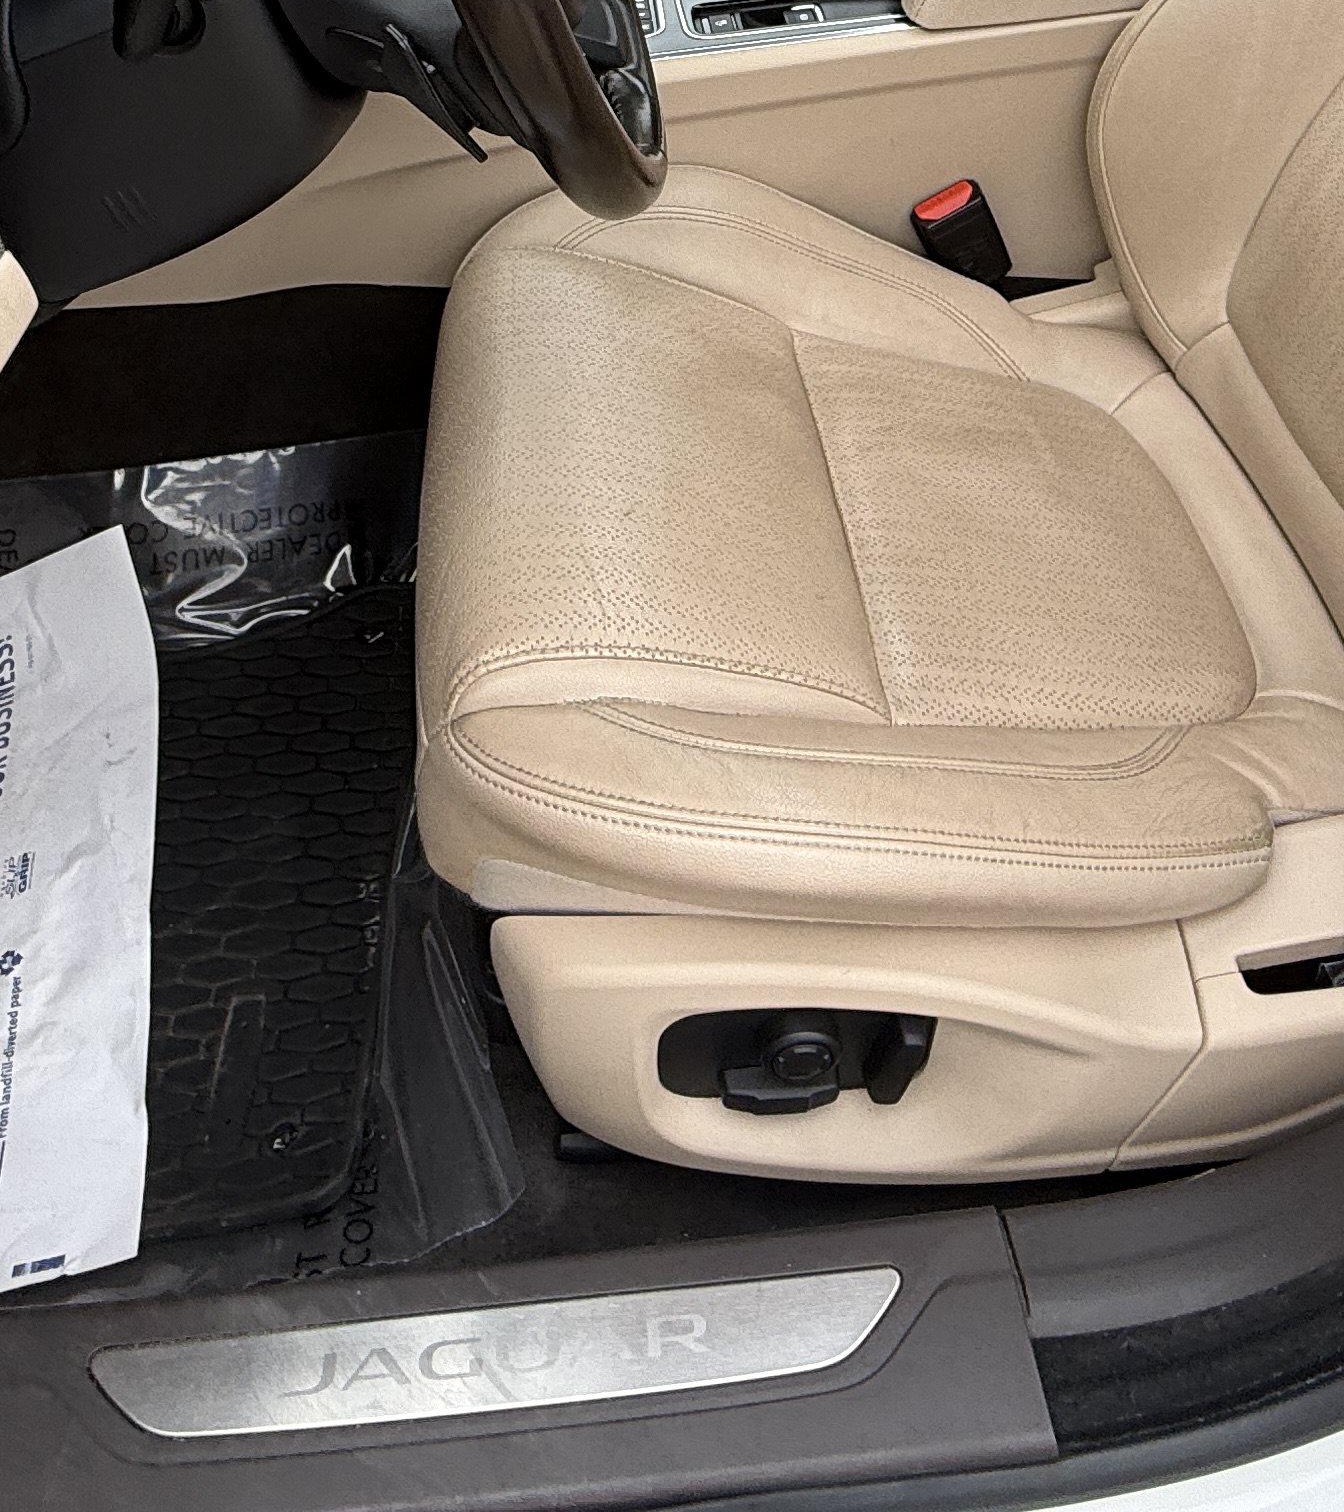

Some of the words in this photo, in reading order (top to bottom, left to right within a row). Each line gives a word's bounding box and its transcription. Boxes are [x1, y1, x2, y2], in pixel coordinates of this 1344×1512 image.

[150, 545, 226, 575] MUST
[247, 532, 342, 564] DEALER
[9, 976, 24, 1009] paper
[283, 1313, 711, 1397] JAGUR
